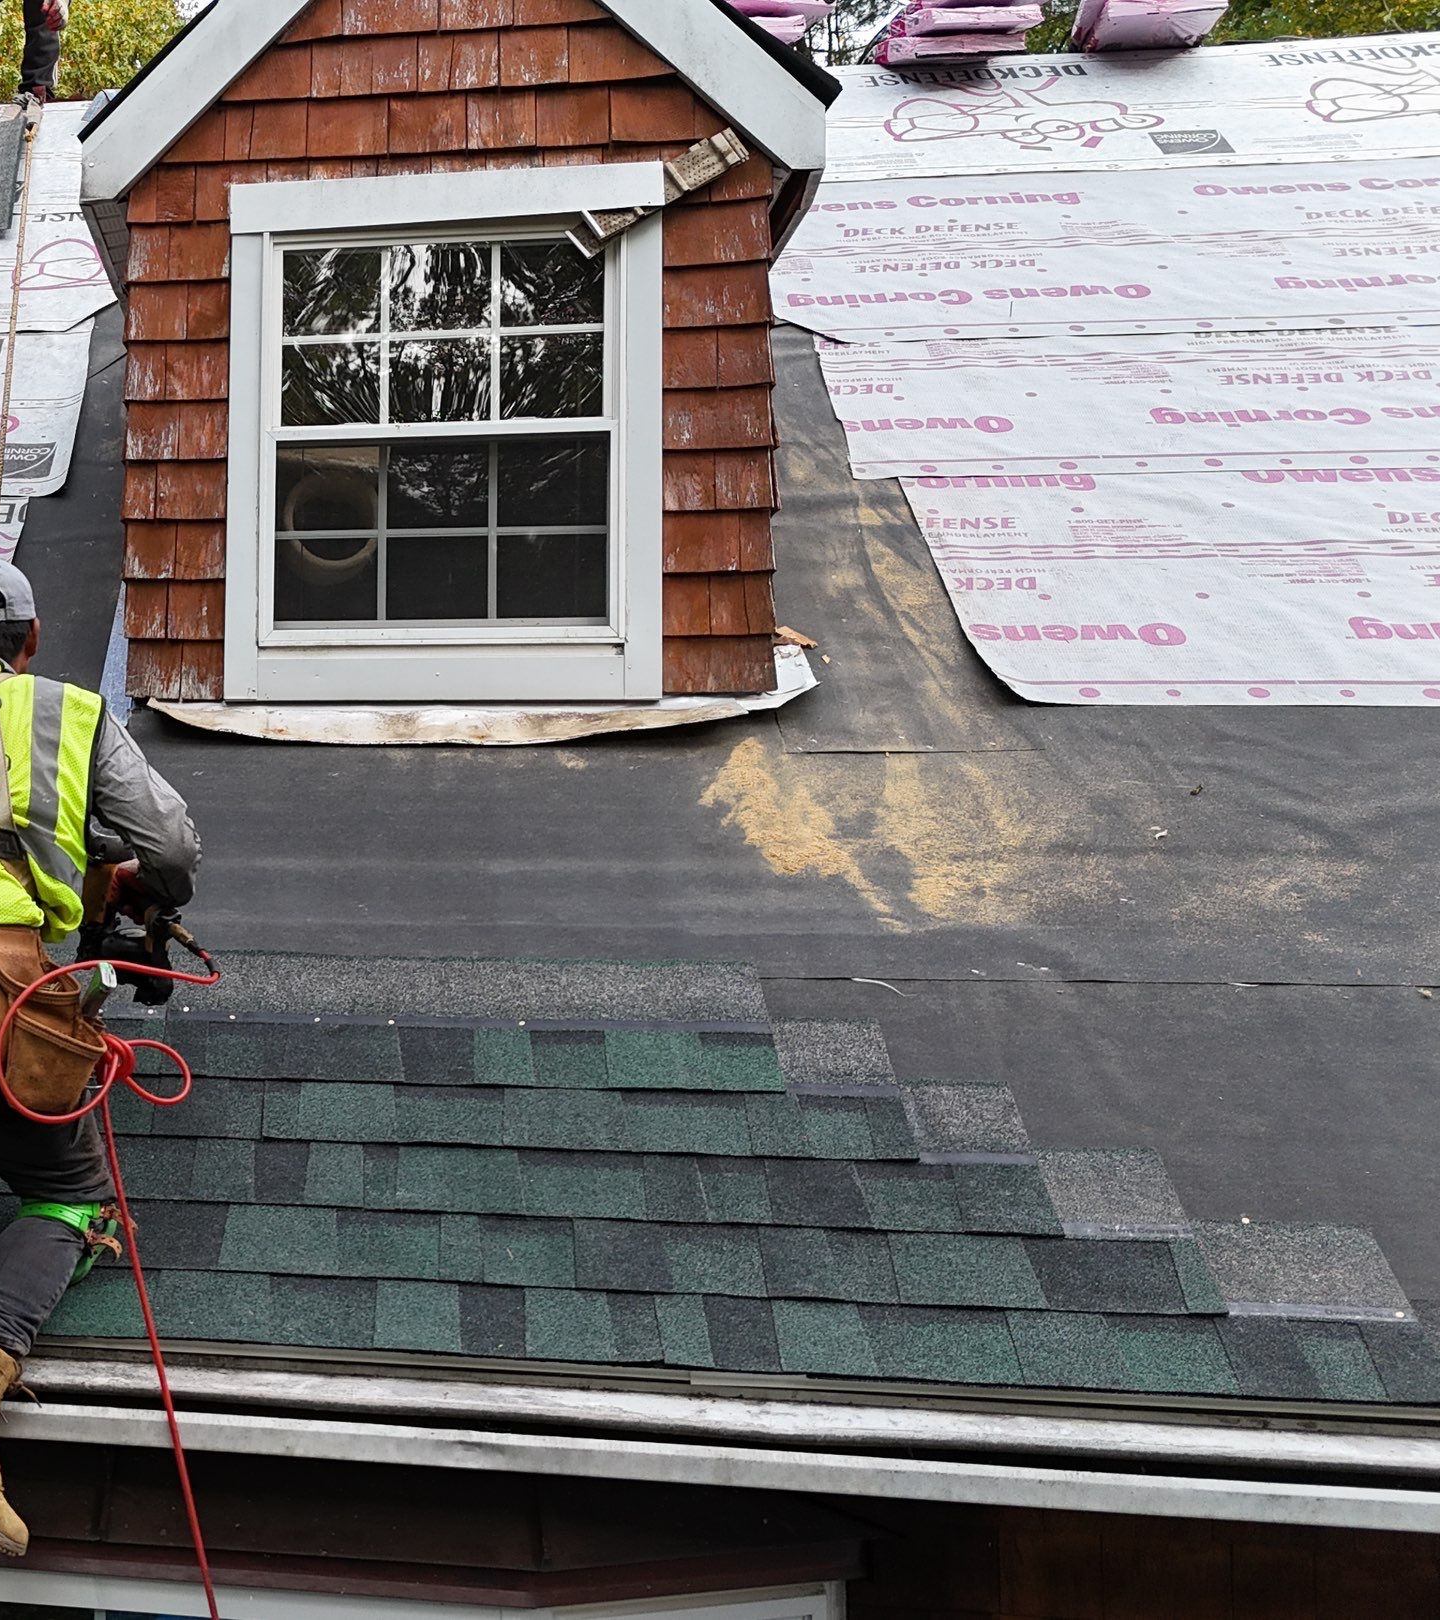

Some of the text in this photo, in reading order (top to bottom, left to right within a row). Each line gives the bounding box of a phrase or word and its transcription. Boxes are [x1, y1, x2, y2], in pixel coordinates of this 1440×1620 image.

[863, 64, 1089, 88] DECKDEFENSE
[1193, 181, 1352, 196] Owens
[808, 192, 1081, 213] ens Corning
[1305, 209, 1373, 220] DECK
[843, 222, 1020, 238] DECK DEFENSE
[853, 259, 1036, 273] DECK DEFENSE
[1273, 273, 1440, 292] orning
[787, 284, 1151, 308] Owens Corning
[1220, 369, 1433, 386] DECK DEFENSE
[842, 415, 1015, 433] Owens
[1148, 406, 1372, 428] Corning
[902, 474, 1096, 491] orning
[954, 576, 1037, 591] DECK
[968, 622, 1187, 646] Owens
